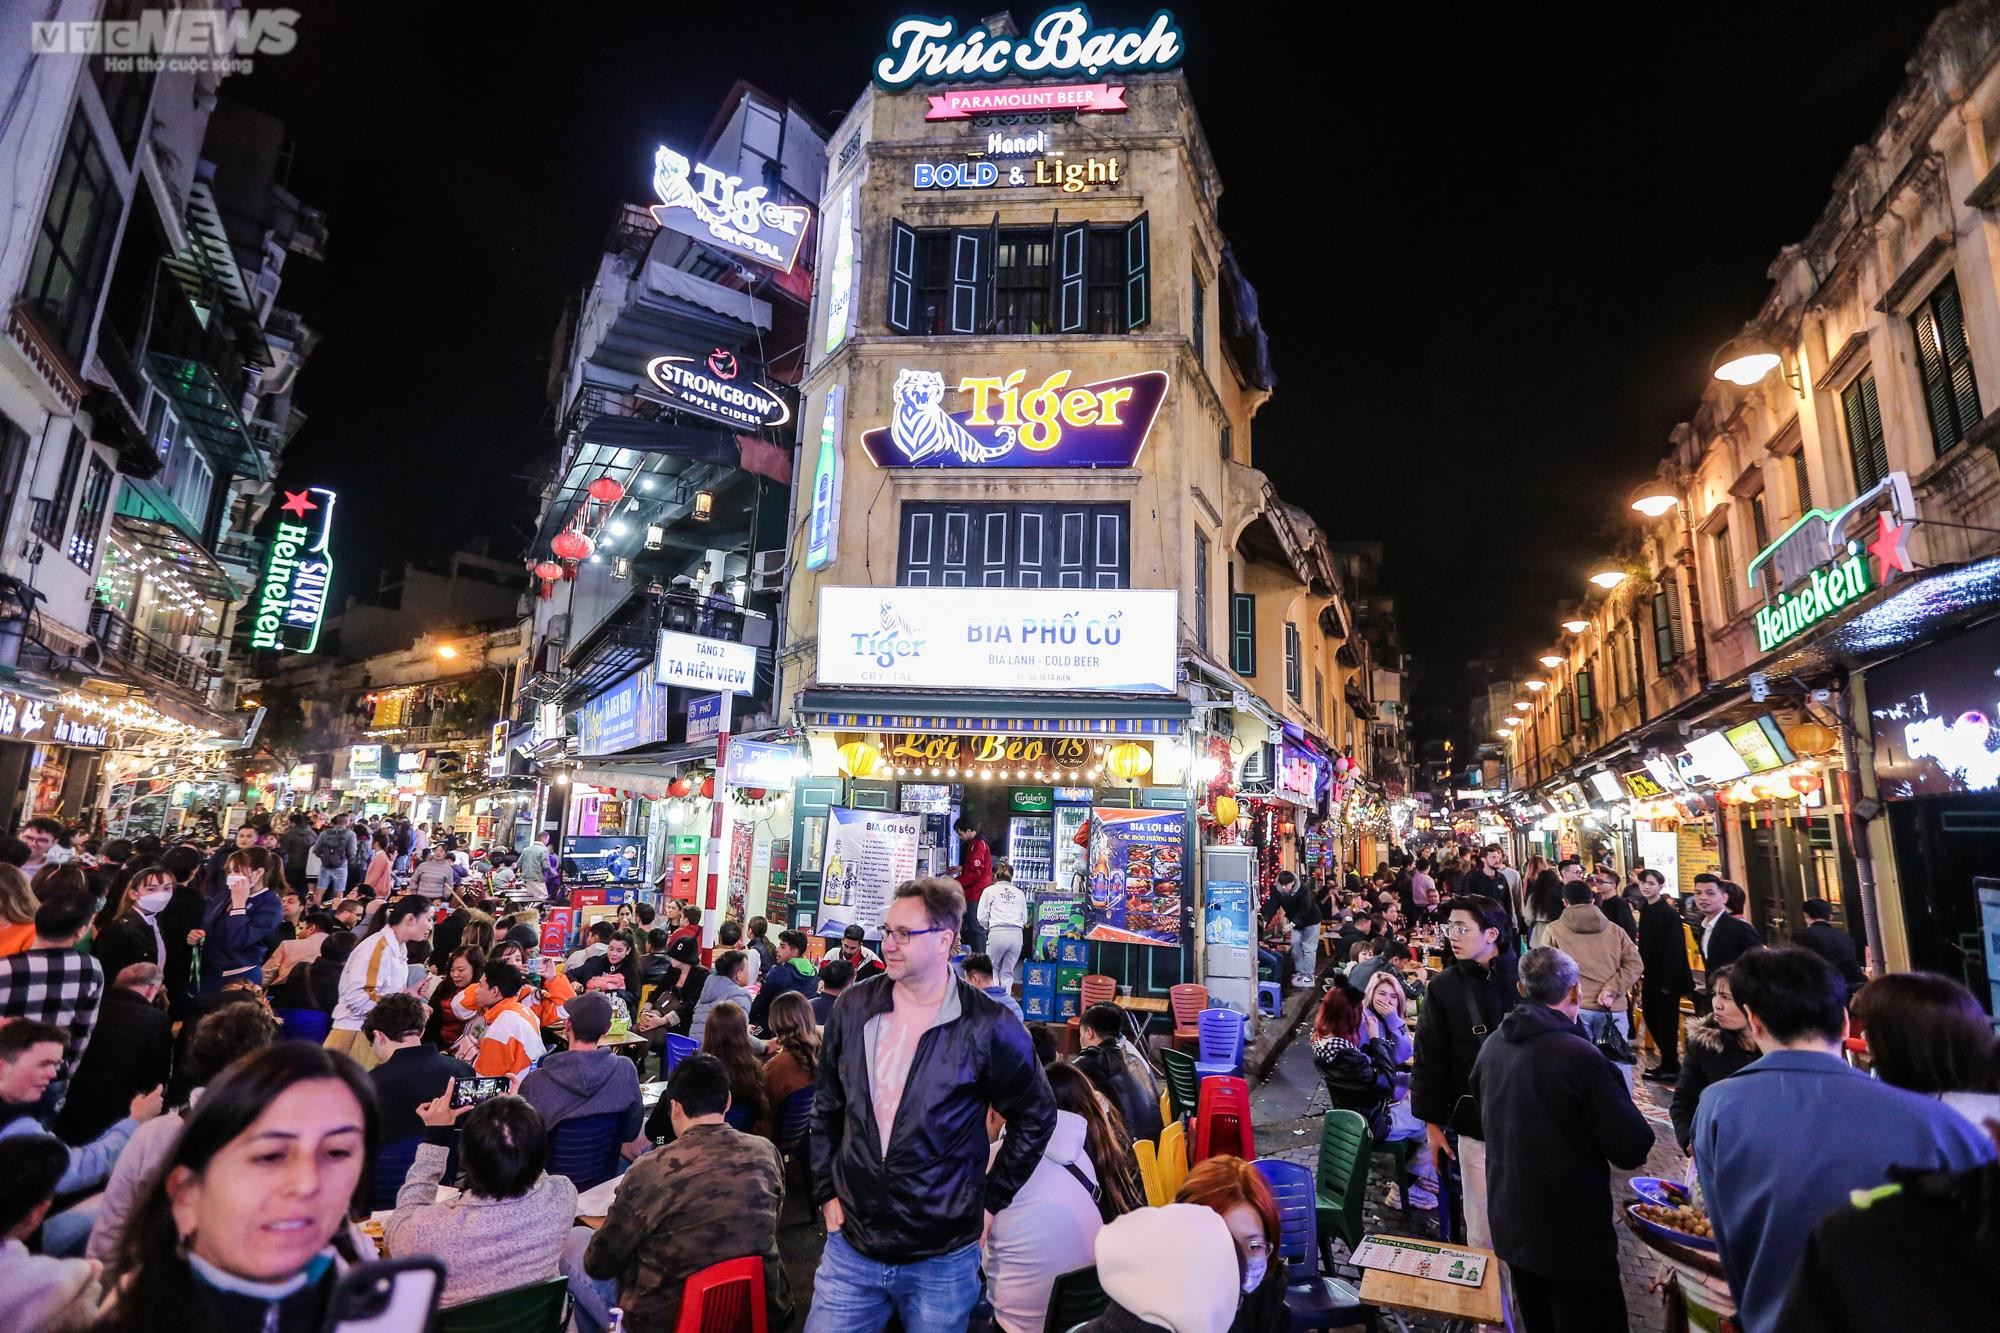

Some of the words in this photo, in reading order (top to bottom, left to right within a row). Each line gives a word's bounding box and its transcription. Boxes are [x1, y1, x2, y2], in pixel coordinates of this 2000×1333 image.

[878, 20, 1011, 83] Trúc
[1014, 7, 1179, 75] Bạch
[951, 93, 1052, 109] PARAMOUNT
[1057, 90, 1094, 104] BEER
[914, 162, 998, 189] BOLD
[1008, 166, 1026, 186] &
[1035, 156, 1120, 193] Light
[694, 162, 804, 236] Tiger
[709, 222, 783, 262] CRYSTAL
[680, 391, 718, 412] APPLE
[720, 406, 761, 425] CIDERS
[958, 368, 1133, 452] Tiger
[252, 522, 309, 648] Heineken
[288, 561, 328, 623] SILVER
[1756, 556, 1866, 652] Heineken
[967, 618, 1012, 643] BIA
[1022, 611, 1079, 645] PHỐ
[1086, 610, 1123, 646] CỔ
[720, 647, 725, 658] 2
[851, 630, 926, 668] Tiger
[989, 654, 1006, 665] BIA
[1045, 655, 1071, 666] COLD
[1074, 656, 1100, 667] BEER
[669, 660, 683, 678] TẠ
[686, 662, 713, 681] HIỆN
[717, 667, 746, 685] VIEW
[861, 671, 912, 682] CRYSTAL
[699, 700, 711, 714] PHỐ
[893, 735, 960, 765] Lợi
[971, 735, 1047, 762] Béo
[1057, 738, 1086, 756] 18
[1015, 791, 1046, 804] Carlsberg
[866, 822, 880, 831] BIA
[1130, 822, 1145, 831] BIA
[1147, 823, 1162, 834] LỢI
[1163, 822, 1181, 833] BÉO
